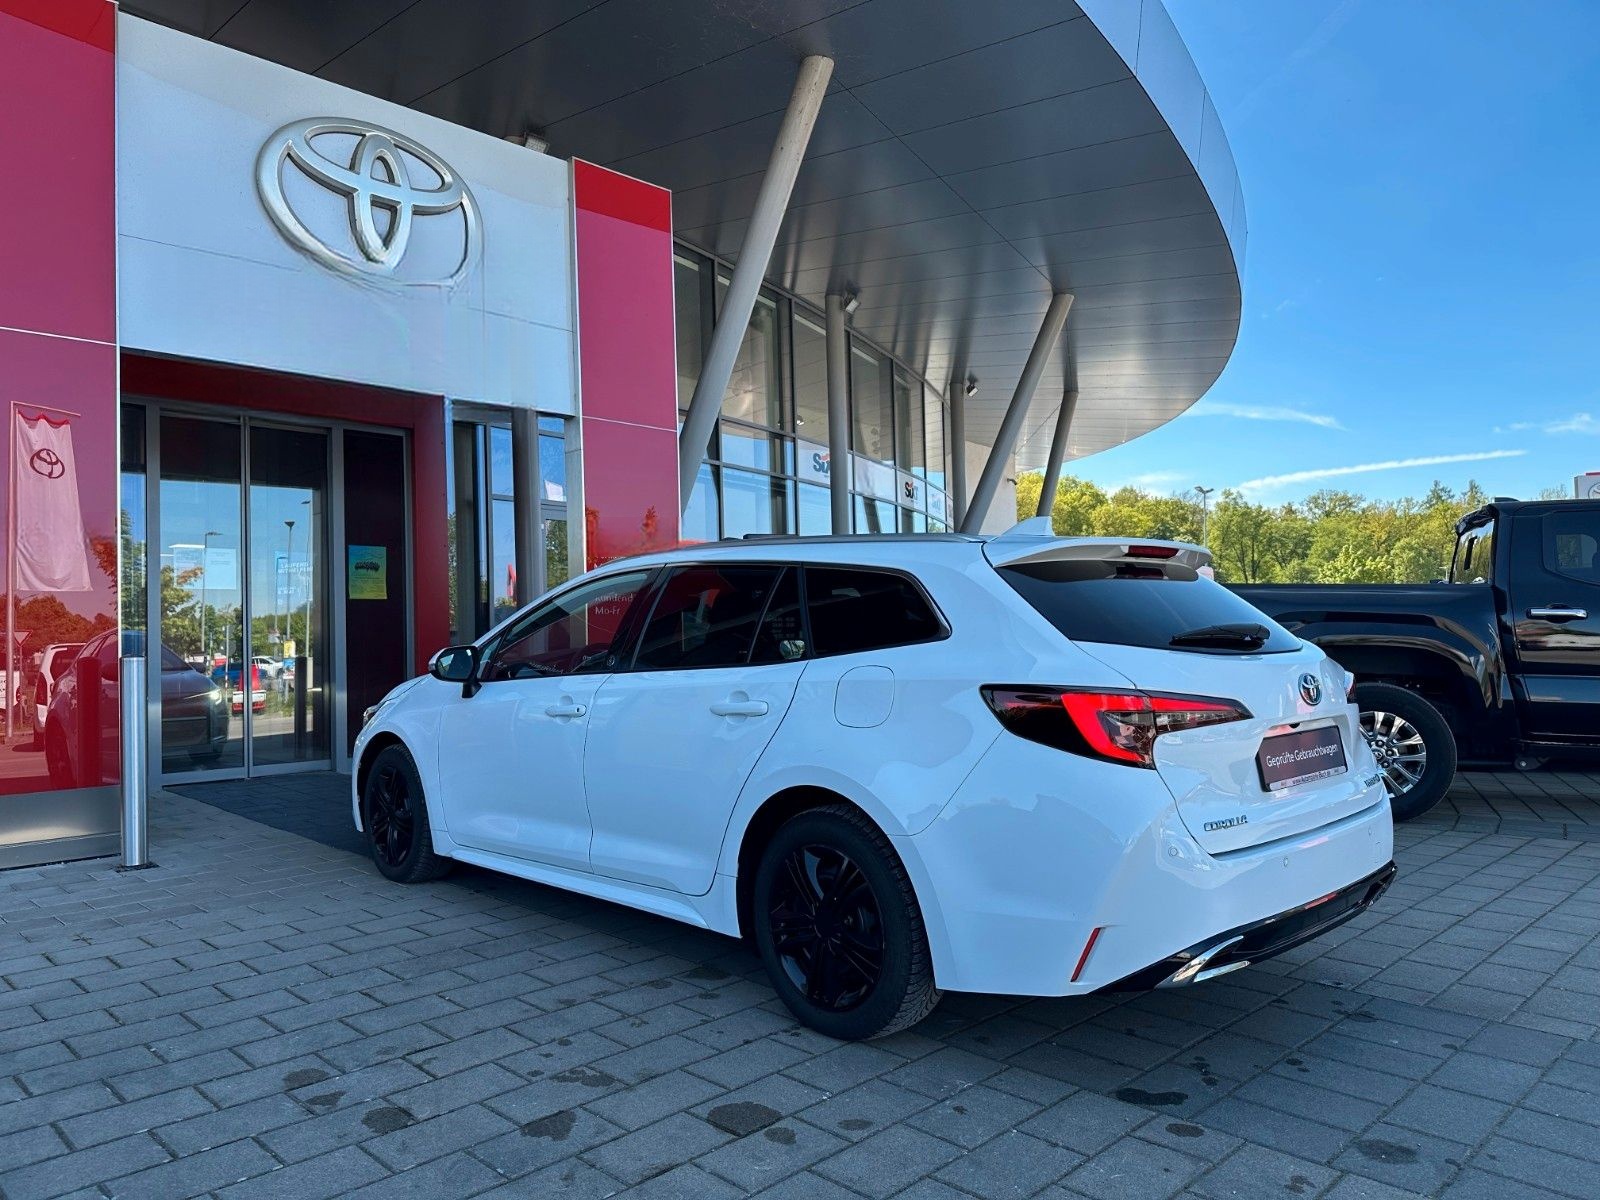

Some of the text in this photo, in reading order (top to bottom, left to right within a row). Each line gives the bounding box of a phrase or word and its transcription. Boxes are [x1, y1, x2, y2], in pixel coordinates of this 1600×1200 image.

[1266, 744, 1338, 768] Geprüfte Gebrauchtwagen
[1203, 814, 1248, 831] COROLLA
